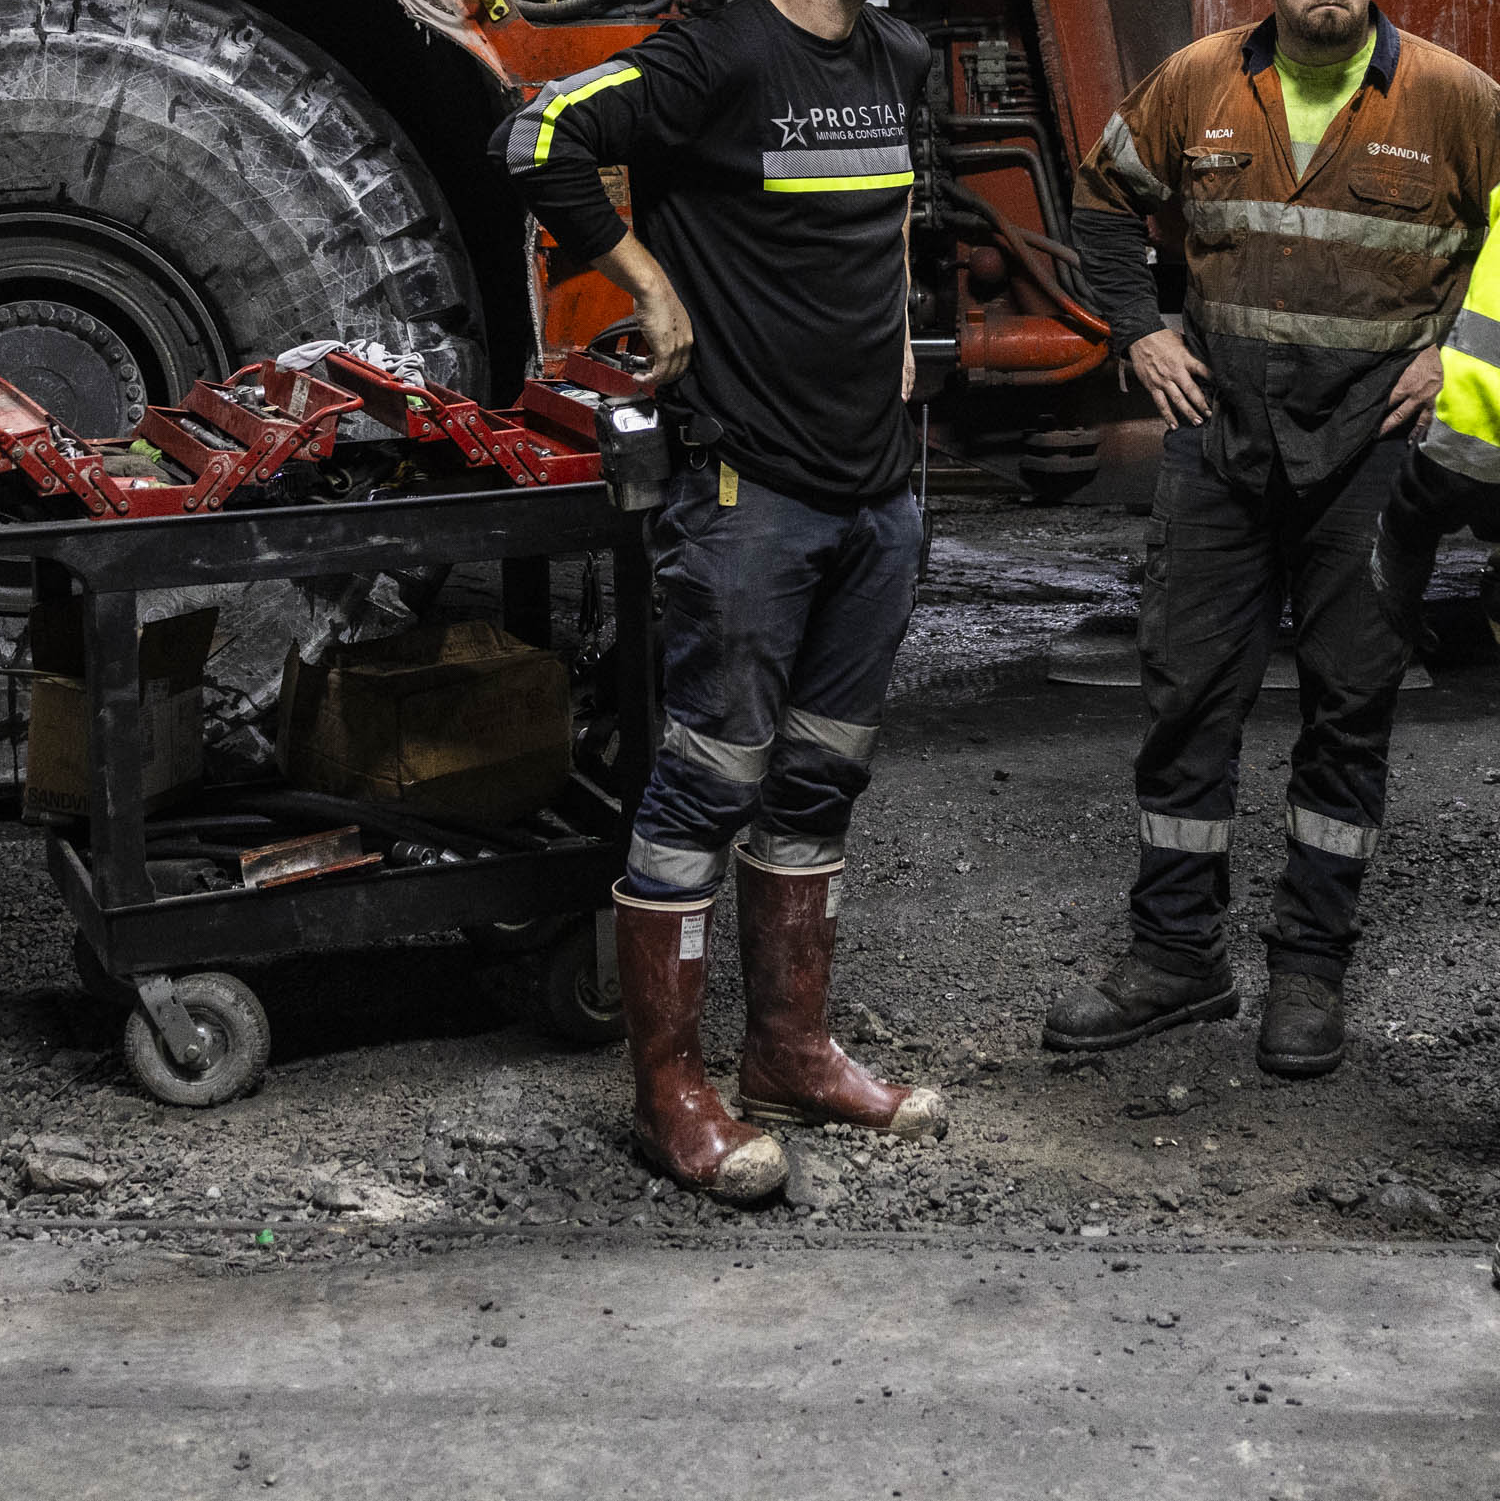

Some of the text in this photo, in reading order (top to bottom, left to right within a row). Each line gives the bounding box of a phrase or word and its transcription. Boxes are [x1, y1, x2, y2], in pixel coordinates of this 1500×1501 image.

[809, 102, 906, 128] PROSTAR
[815, 131, 847, 141] MINING
[848, 130, 855, 140] &
[28, 788, 91, 812] SANDVI
